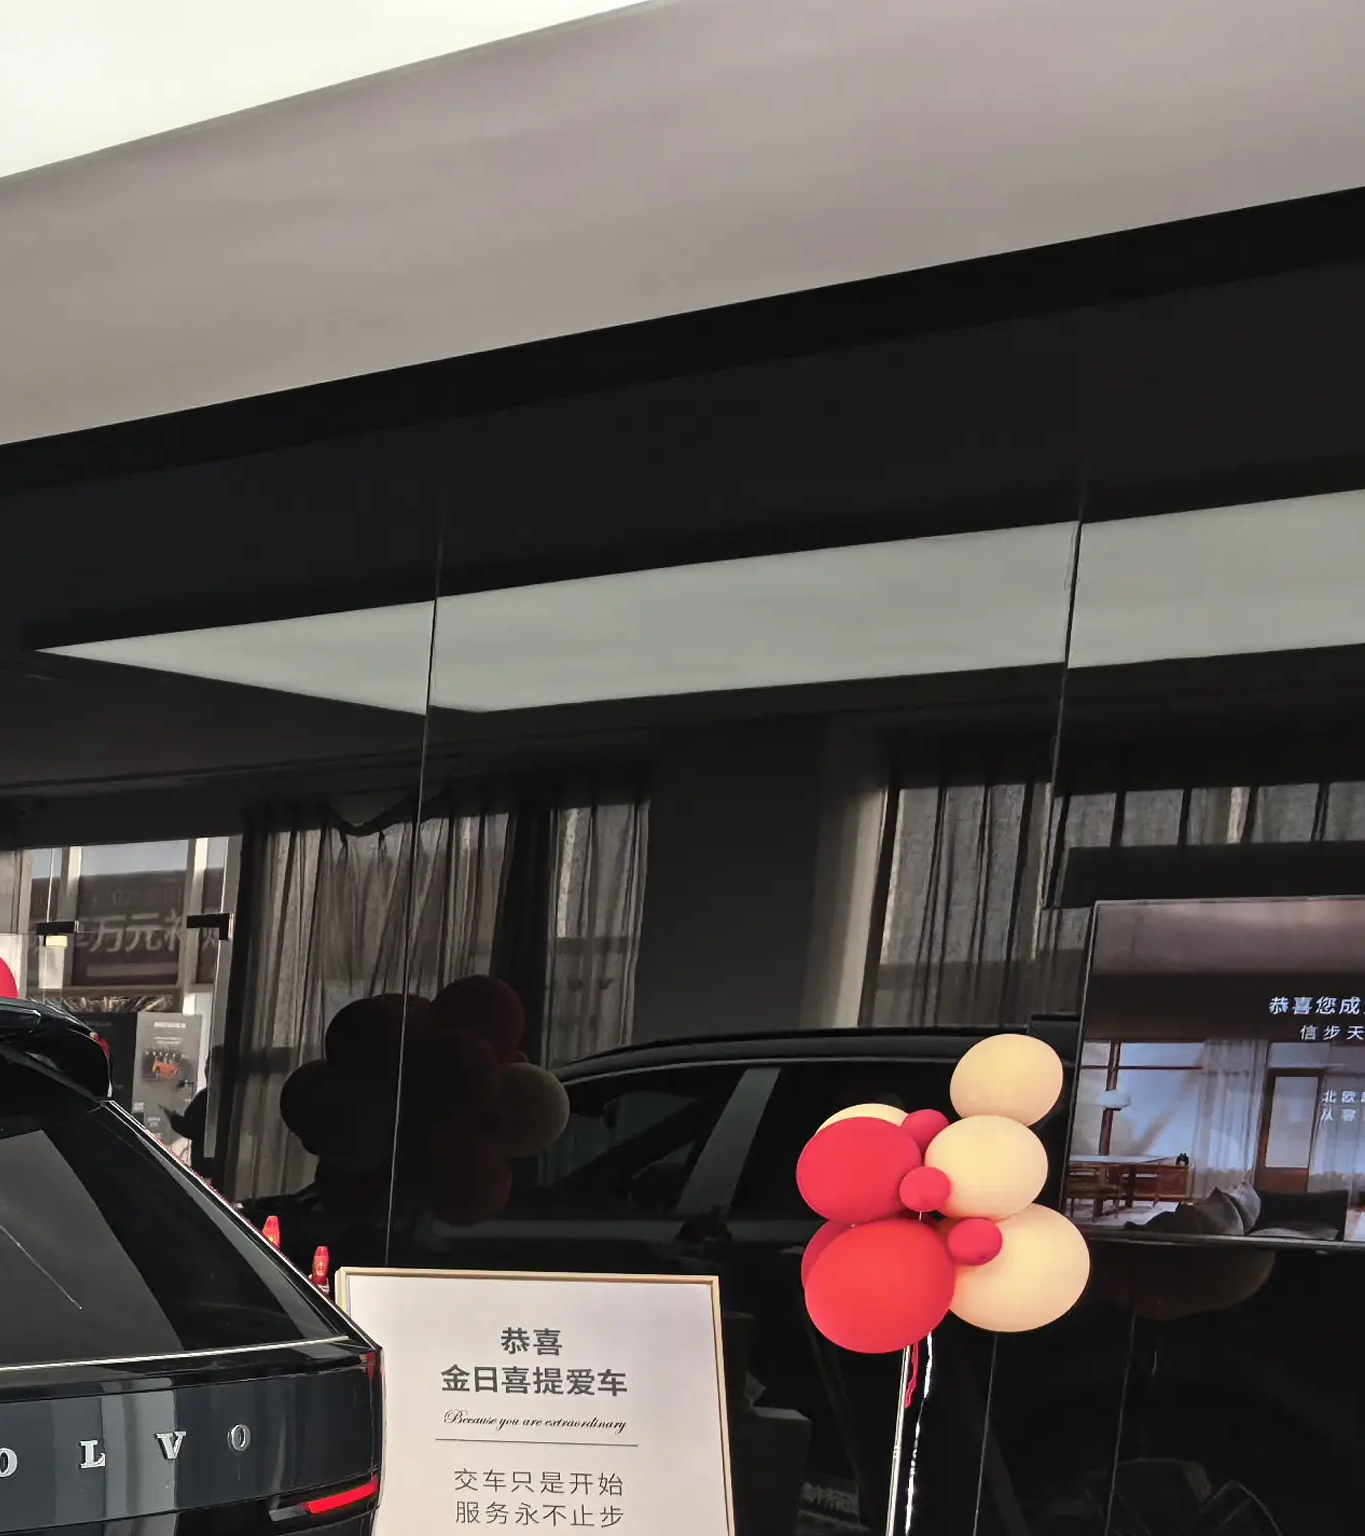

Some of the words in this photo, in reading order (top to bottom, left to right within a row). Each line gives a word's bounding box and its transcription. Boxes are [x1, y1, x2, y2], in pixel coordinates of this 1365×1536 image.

[1268, 996, 1365, 1015] 恭喜您成
[1321, 1090, 1365, 1104] 北欧
[500, 1326, 563, 1356] 恭喜
[440, 1364, 628, 1397] 金日喜提爱车
[443, 1408, 497, 1425] Because
[496, 1417, 520, 1432] you
[522, 1417, 542, 1427] are
[544, 1416, 627, 1435] extraordinary
[453, 1467, 624, 1496] 交车只是开始
[455, 1500, 625, 1528] 服务永不止步
